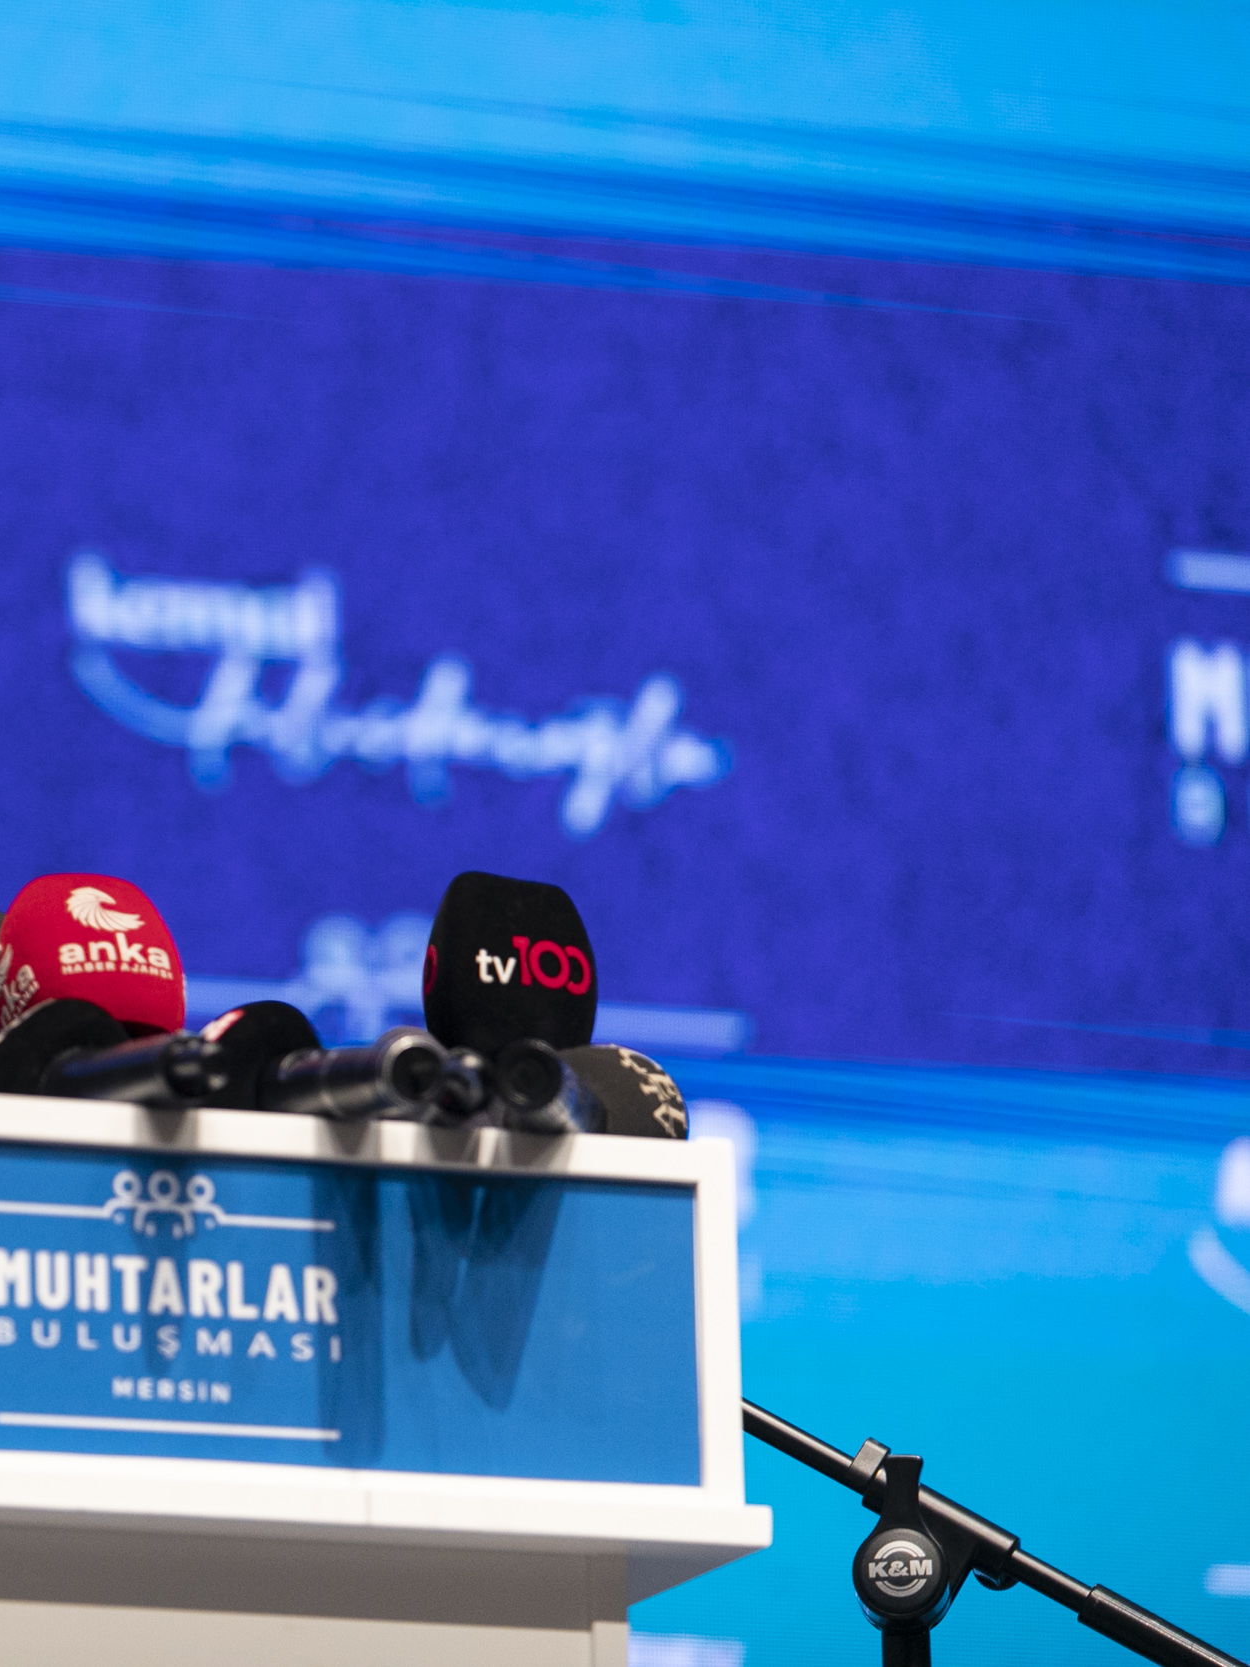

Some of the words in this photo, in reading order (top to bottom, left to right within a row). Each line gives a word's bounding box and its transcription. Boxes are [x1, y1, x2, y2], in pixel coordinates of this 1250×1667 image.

[58, 931, 172, 971] anka
[474, 934, 592, 997] tv100
[61, 962, 117, 976] HABER
[867, 1558, 933, 1579] K&M
